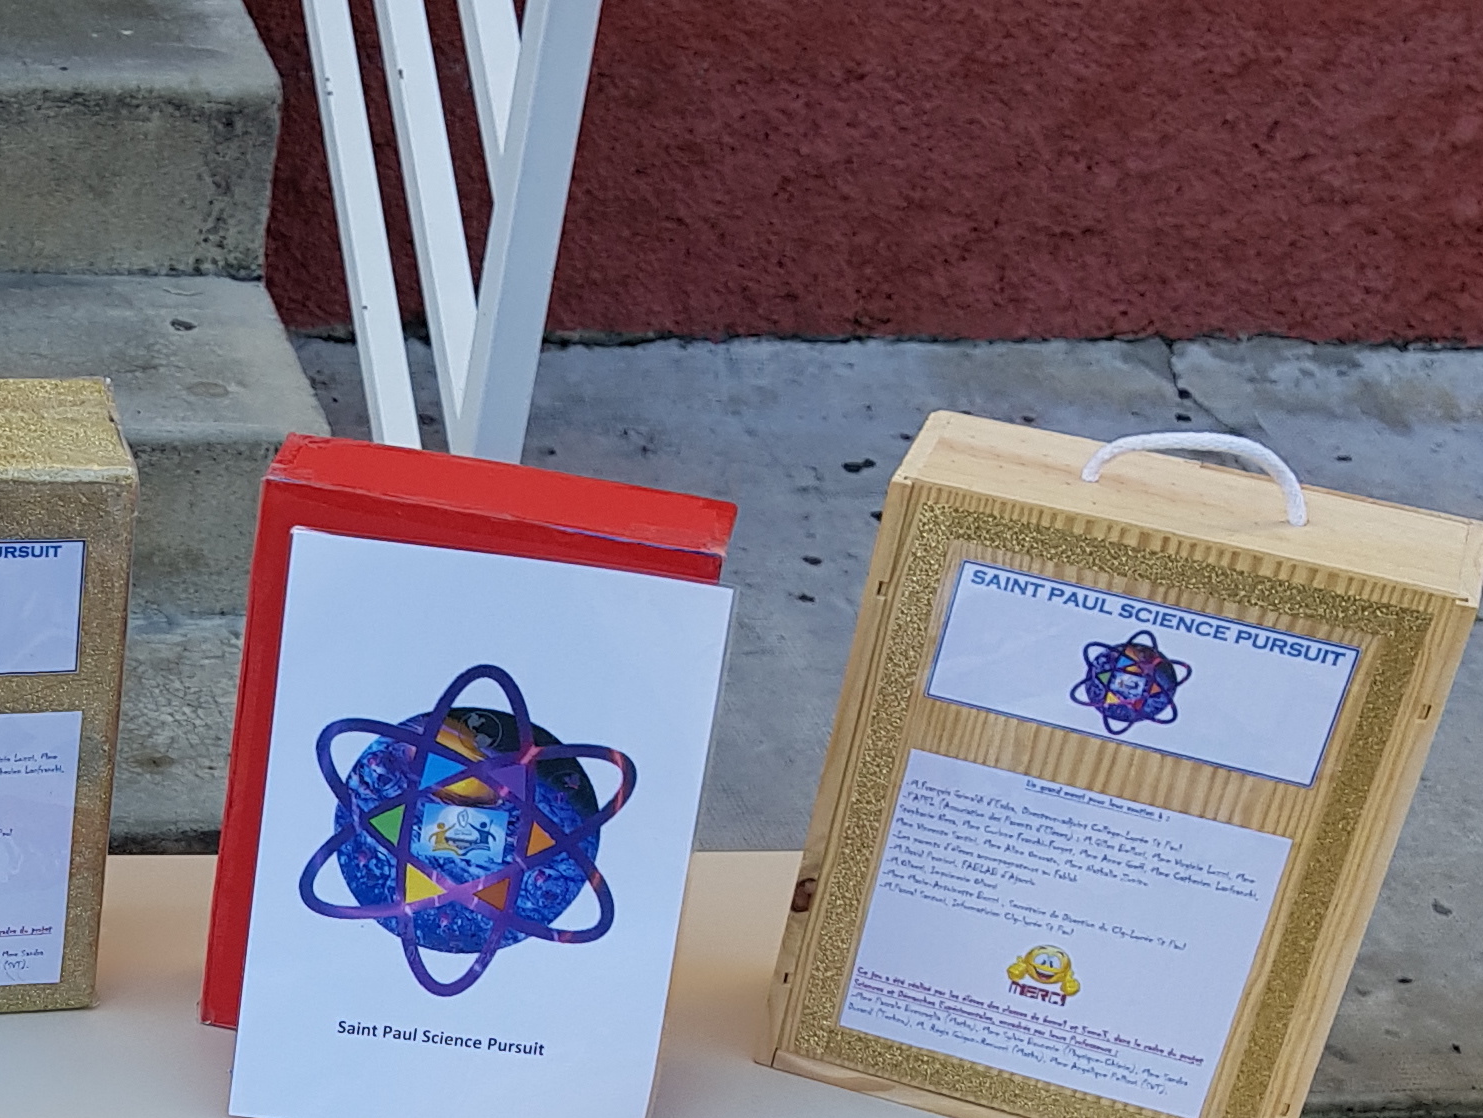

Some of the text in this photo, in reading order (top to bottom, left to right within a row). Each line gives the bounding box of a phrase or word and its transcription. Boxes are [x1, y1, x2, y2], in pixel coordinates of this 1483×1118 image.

[971, 569, 1343, 666] SAINT PAUL SCIENCE PURSUIT
[336, 1019, 544, 1056] Saint Paul Science Pursuit
